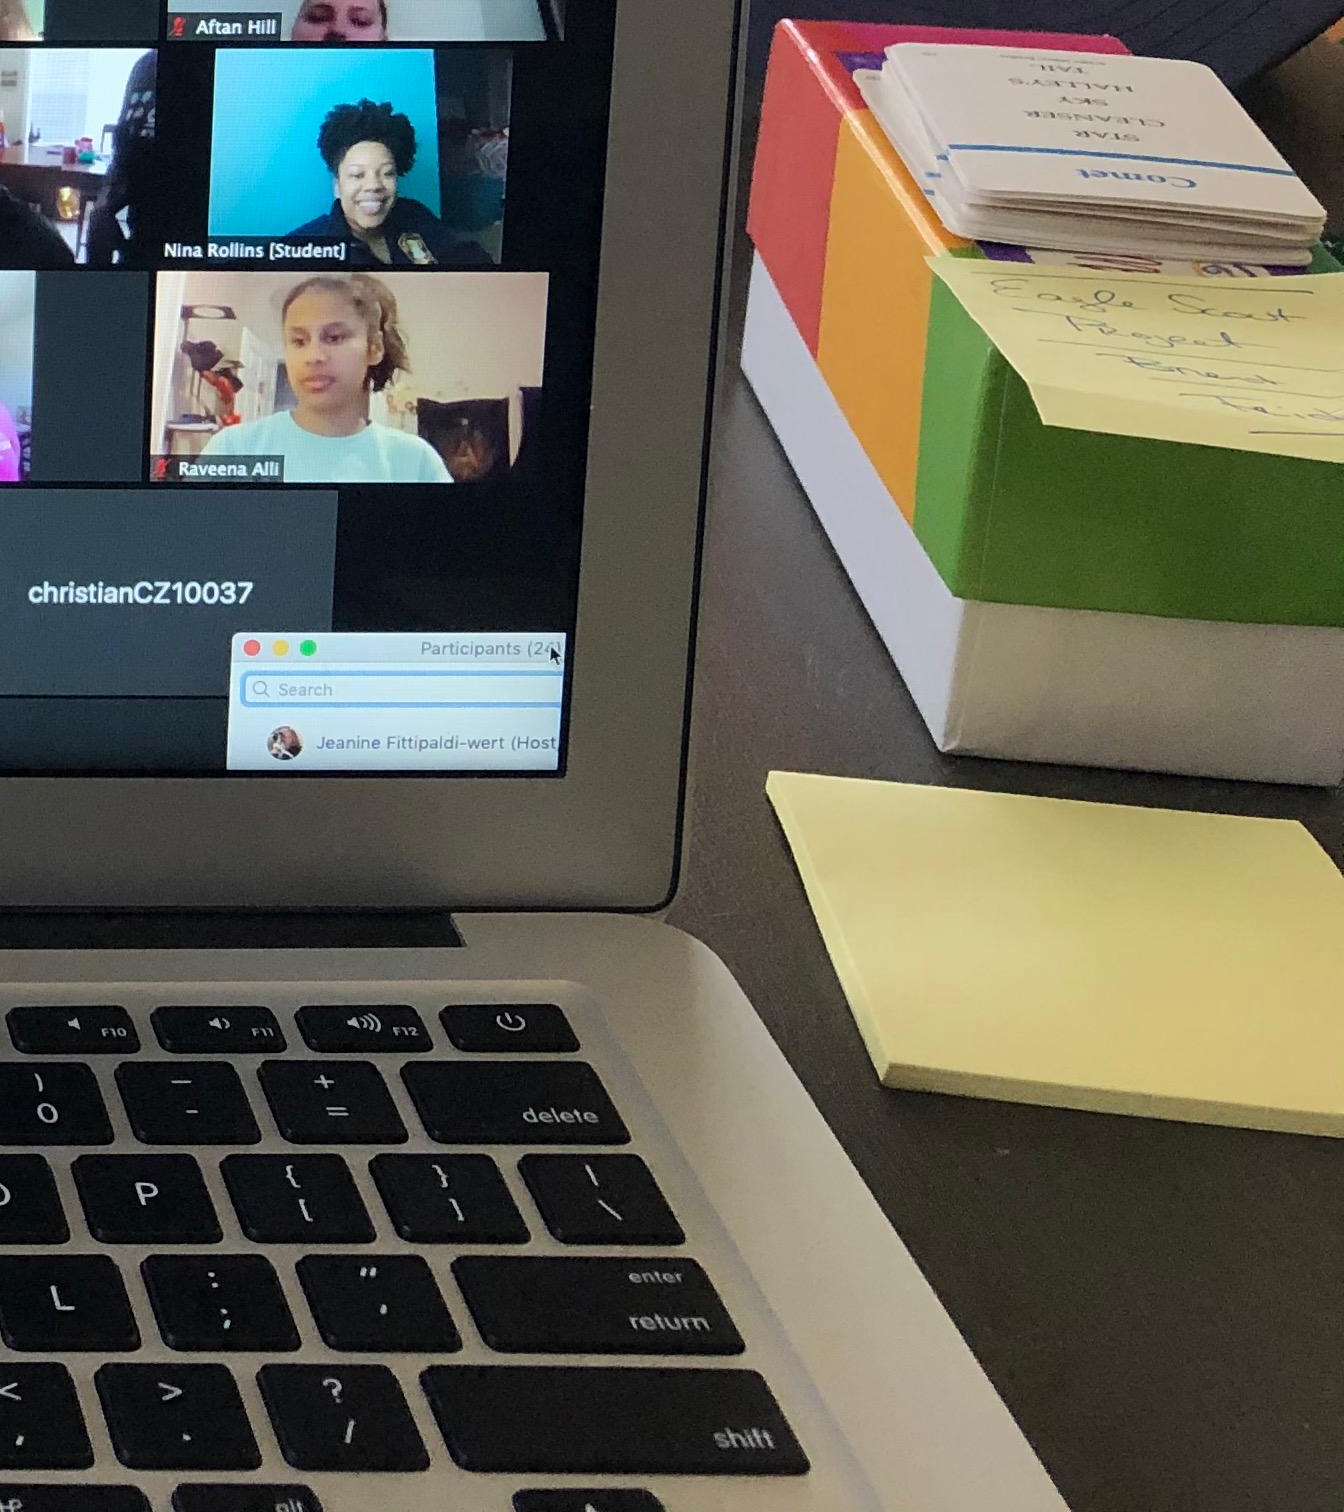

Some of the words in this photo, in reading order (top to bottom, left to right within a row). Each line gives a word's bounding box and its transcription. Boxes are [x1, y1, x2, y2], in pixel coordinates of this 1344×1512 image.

[195, 18, 242, 36] Aftan
[246, 18, 278, 36] Hill
[1057, 95, 1109, 106] SKY
[1023, 110, 1166, 128] CLEANSER
[1072, 130, 1141, 142] STAR
[1075, 168, 1198, 189] Comet
[164, 242, 204, 258] Nina
[207, 241, 265, 258] Rollins
[269, 241, 346, 261] [Student]
[179, 461, 248, 477] Raveena
[251, 461, 280, 477] Alli
[28, 580, 254, 605] christianCZ10037
[421, 642, 521, 658] Participants
[279, 683, 333, 697] Search
[316, 736, 381, 751] Jeanine
[387, 736, 506, 753] Fittipaldi-wert
[522, 1107, 599, 1124] delete
[134, 1182, 159, 1206] P
[628, 1271, 682, 1284] enter
[628, 1313, 710, 1331] return
[713, 1427, 775, 1449] shift
